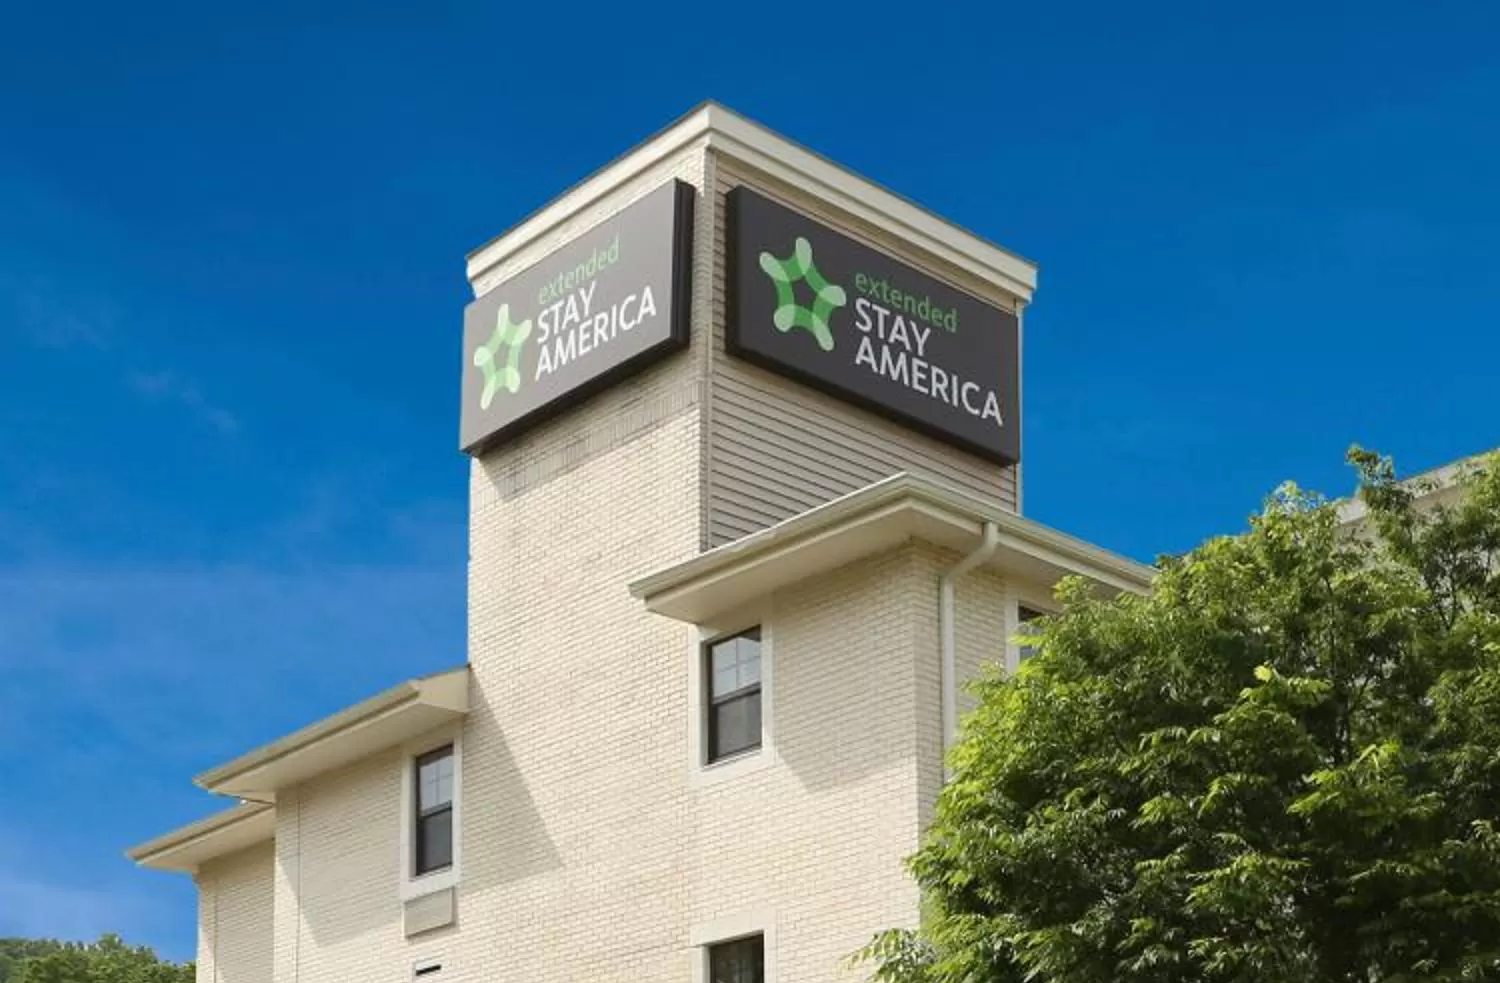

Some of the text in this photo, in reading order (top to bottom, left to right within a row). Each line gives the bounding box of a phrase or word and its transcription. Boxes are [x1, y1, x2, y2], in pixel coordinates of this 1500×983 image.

[539, 232, 619, 304] extended
[534, 285, 657, 382] AMERICA
[537, 280, 596, 343] STAY
[855, 272, 958, 333] extended
[855, 297, 931, 357] STAY
[855, 336, 1003, 426] AMERICA
